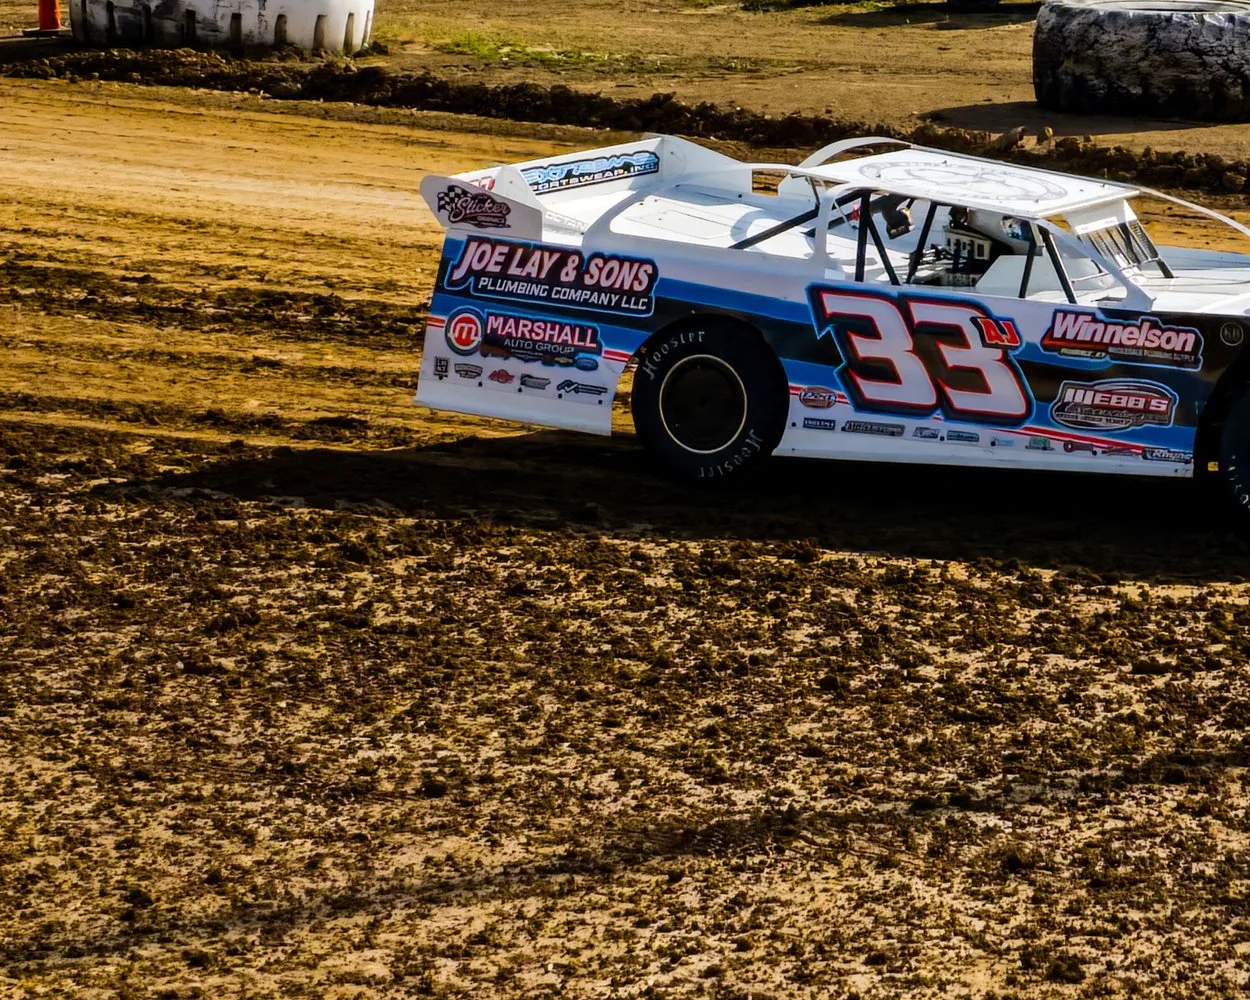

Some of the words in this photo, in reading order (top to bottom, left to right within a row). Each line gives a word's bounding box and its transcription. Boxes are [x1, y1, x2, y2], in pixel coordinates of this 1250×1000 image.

[452, 241, 508, 281] JOE
[507, 247, 561, 279] LAY
[560, 254, 580, 283] &
[583, 257, 653, 292] SONS
[478, 277, 549, 297] PLUMBING
[551, 287, 620, 307] COMPANY
[621, 296, 648, 310] LLC
[486, 315, 597, 348] MARSHALL
[504, 338, 533, 350] AUTO
[536, 342, 575, 354] GROUP
[1053, 312, 1195, 352] Winnelson
[818, 289, 1028, 417] 33
